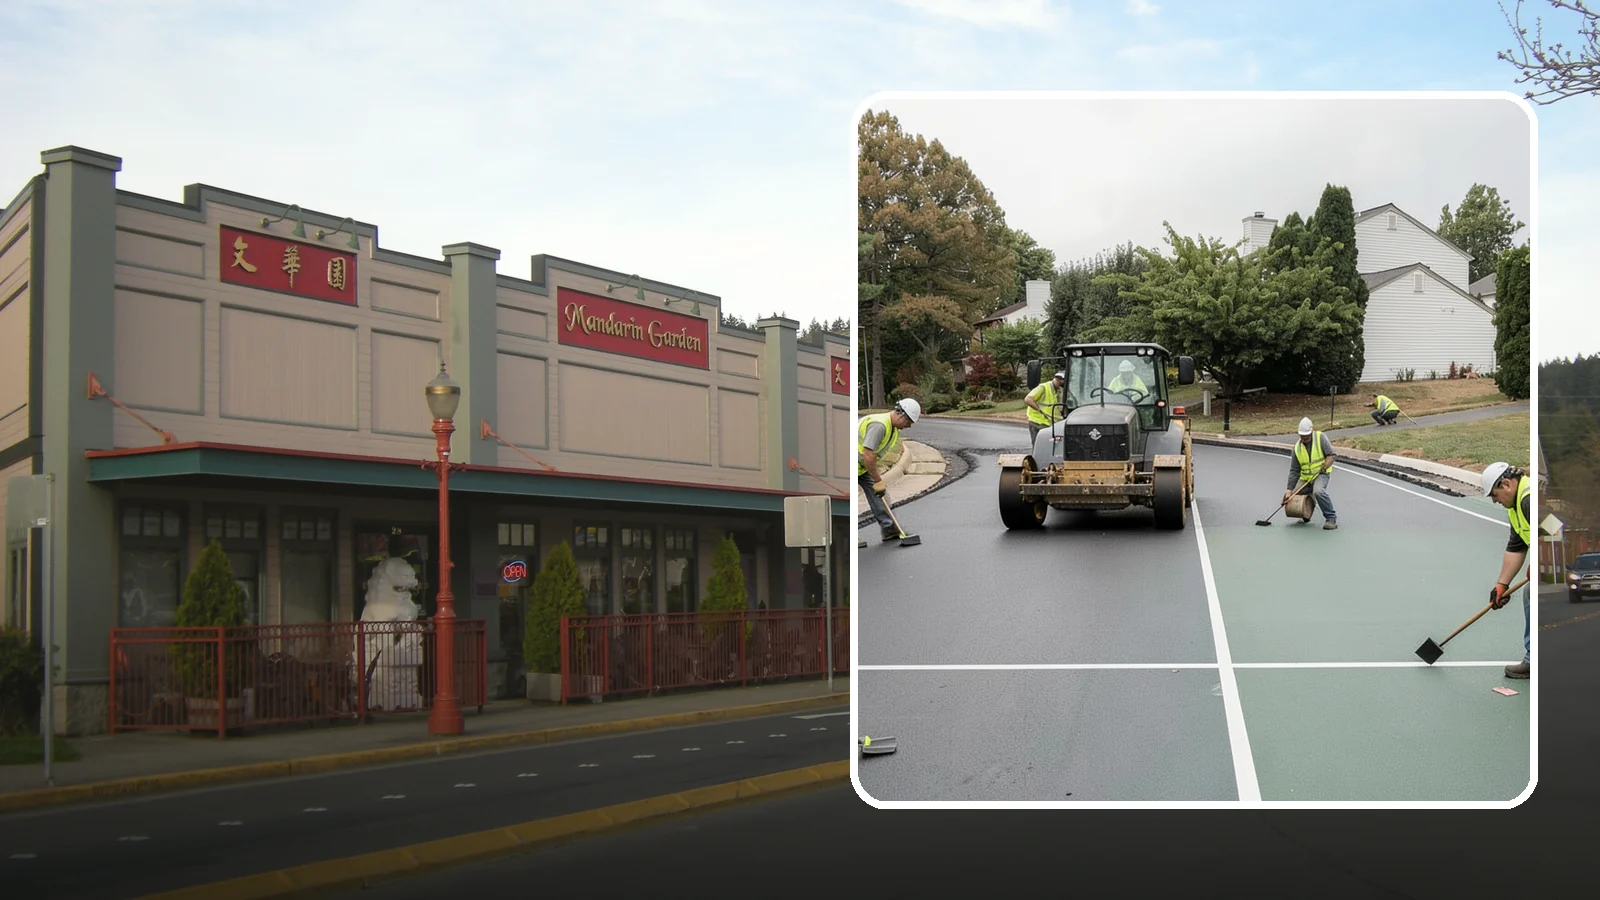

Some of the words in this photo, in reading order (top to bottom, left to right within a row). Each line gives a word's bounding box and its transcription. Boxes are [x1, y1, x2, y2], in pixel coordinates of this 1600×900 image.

[564, 302, 644, 341] Mandarin
[648, 320, 702, 352] Garden
[503, 565, 527, 578] OPEN
